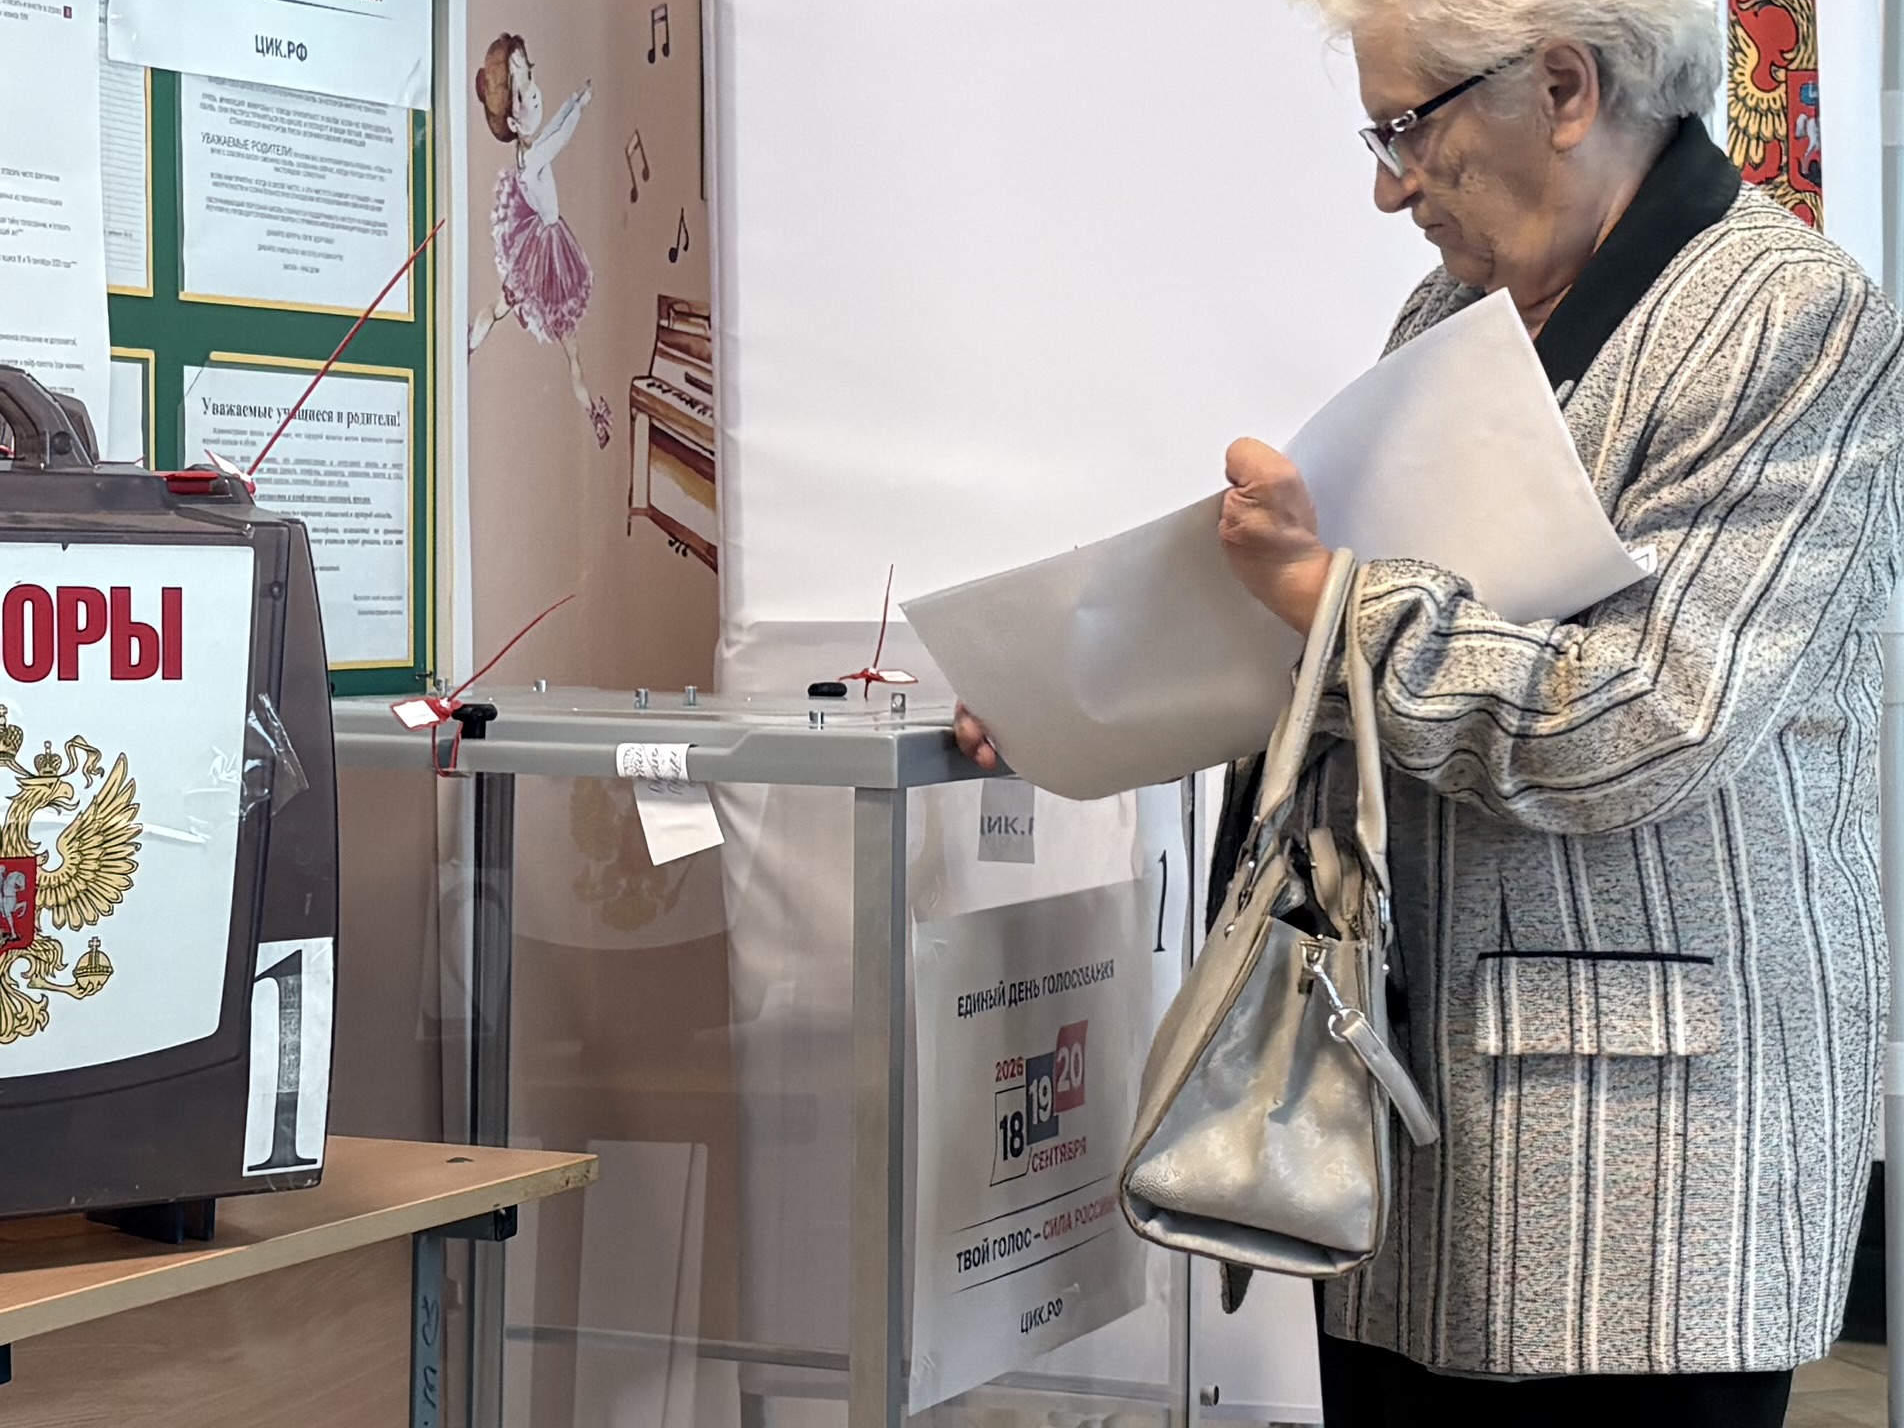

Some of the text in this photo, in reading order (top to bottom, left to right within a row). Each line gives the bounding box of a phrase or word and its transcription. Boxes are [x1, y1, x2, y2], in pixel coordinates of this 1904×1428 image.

[255, 34, 307, 62] ЦИК.РФ
[202, 397, 273, 420] Уважаемые
[338, 412, 343, 423] и
[347, 410, 401, 428] родители!
[980, 814, 1034, 837] ИК.
[1153, 849, 1168, 953] 1
[958, 981, 1006, 1019] ЕДИНЫЙ
[1008, 979, 1040, 1008] ДЕНЬ
[247, 949, 320, 1174] 1
[996, 1056, 1024, 1083] 2026
[1000, 1044, 1083, 1162] 18 19 20
[1031, 1135, 1087, 1173] СЕНТЯБРЯ
[956, 1239, 990, 1273] ТВОЙ
[992, 1226, 1031, 1261] ГОЛОС
[1043, 1212, 1072, 1241] СИЛА
[1020, 1297, 1063, 1334] ЦИК.РФ
